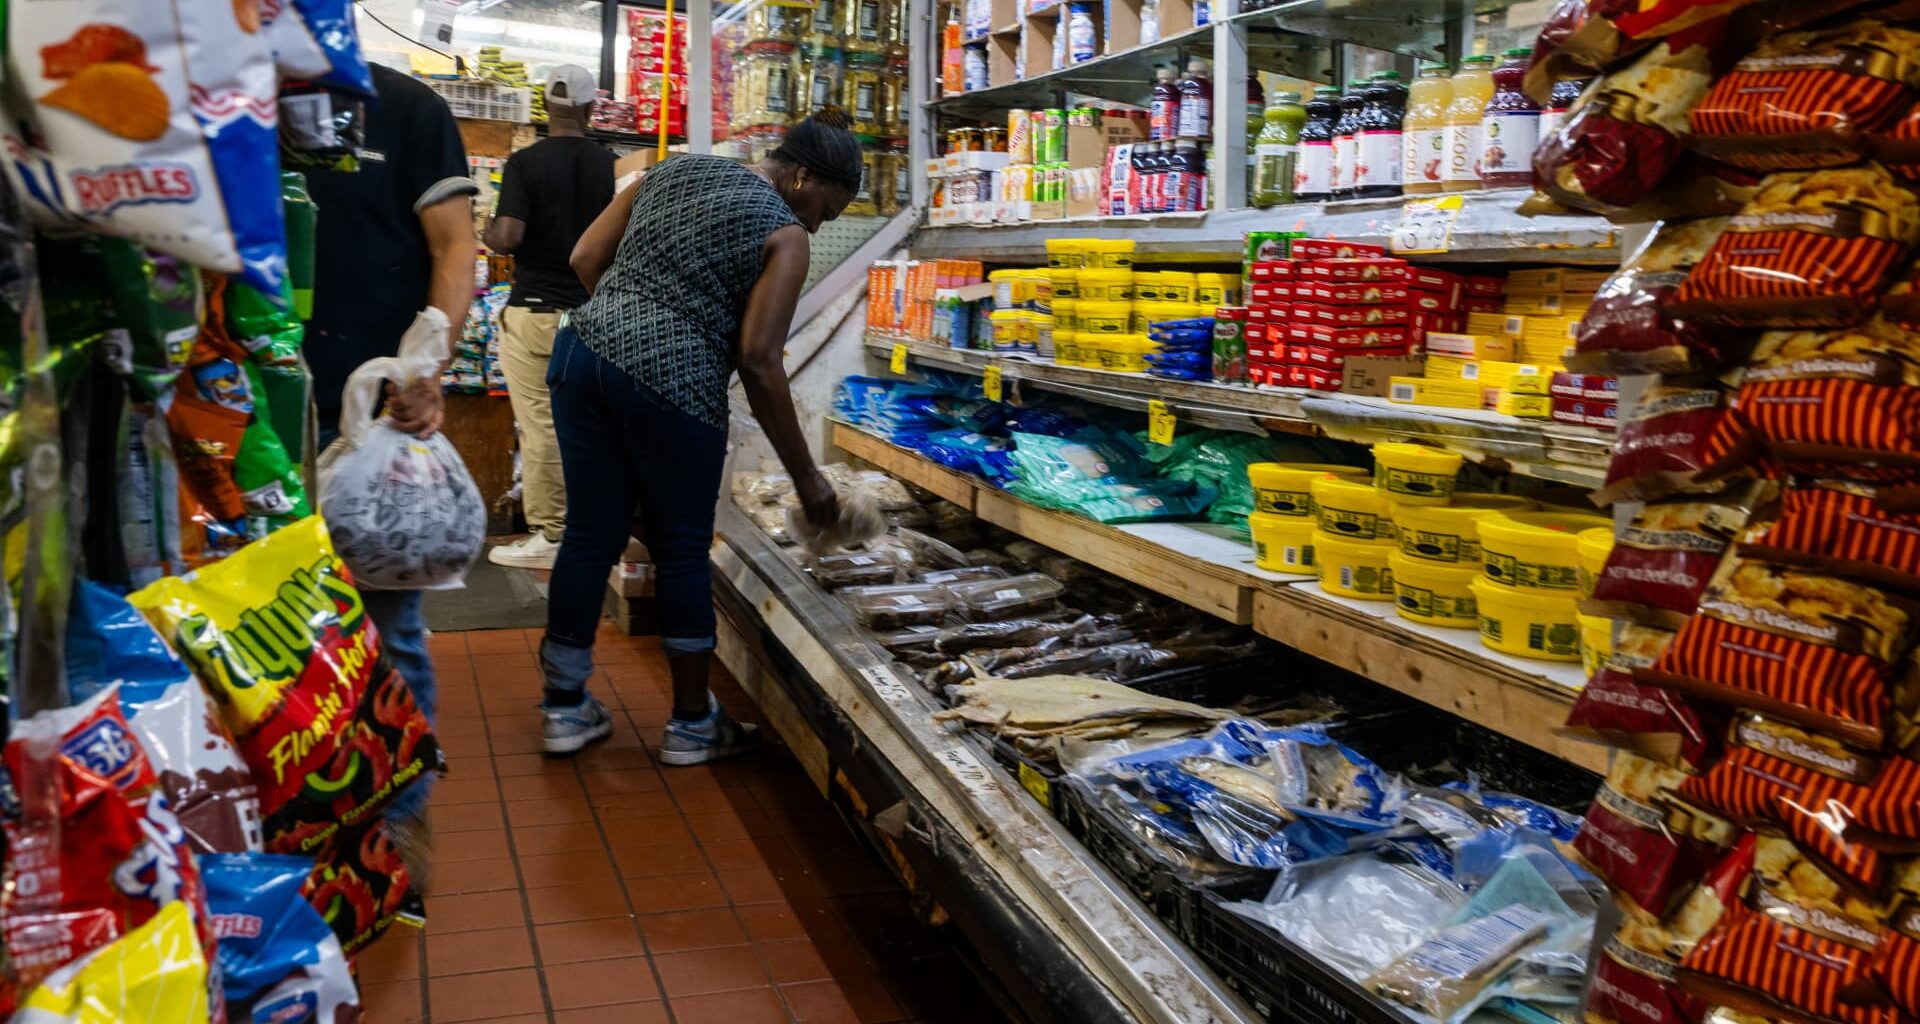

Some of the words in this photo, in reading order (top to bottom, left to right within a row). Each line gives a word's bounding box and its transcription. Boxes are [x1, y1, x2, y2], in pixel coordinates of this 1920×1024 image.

[1407, 132, 1418, 178] 100%
[1452, 127, 1468, 174] 100%
[74, 167, 194, 210] RUFFLES
[301, 822, 340, 850] Onion
[341, 781, 393, 825] Flavored
[392, 757, 425, 787] Rings
